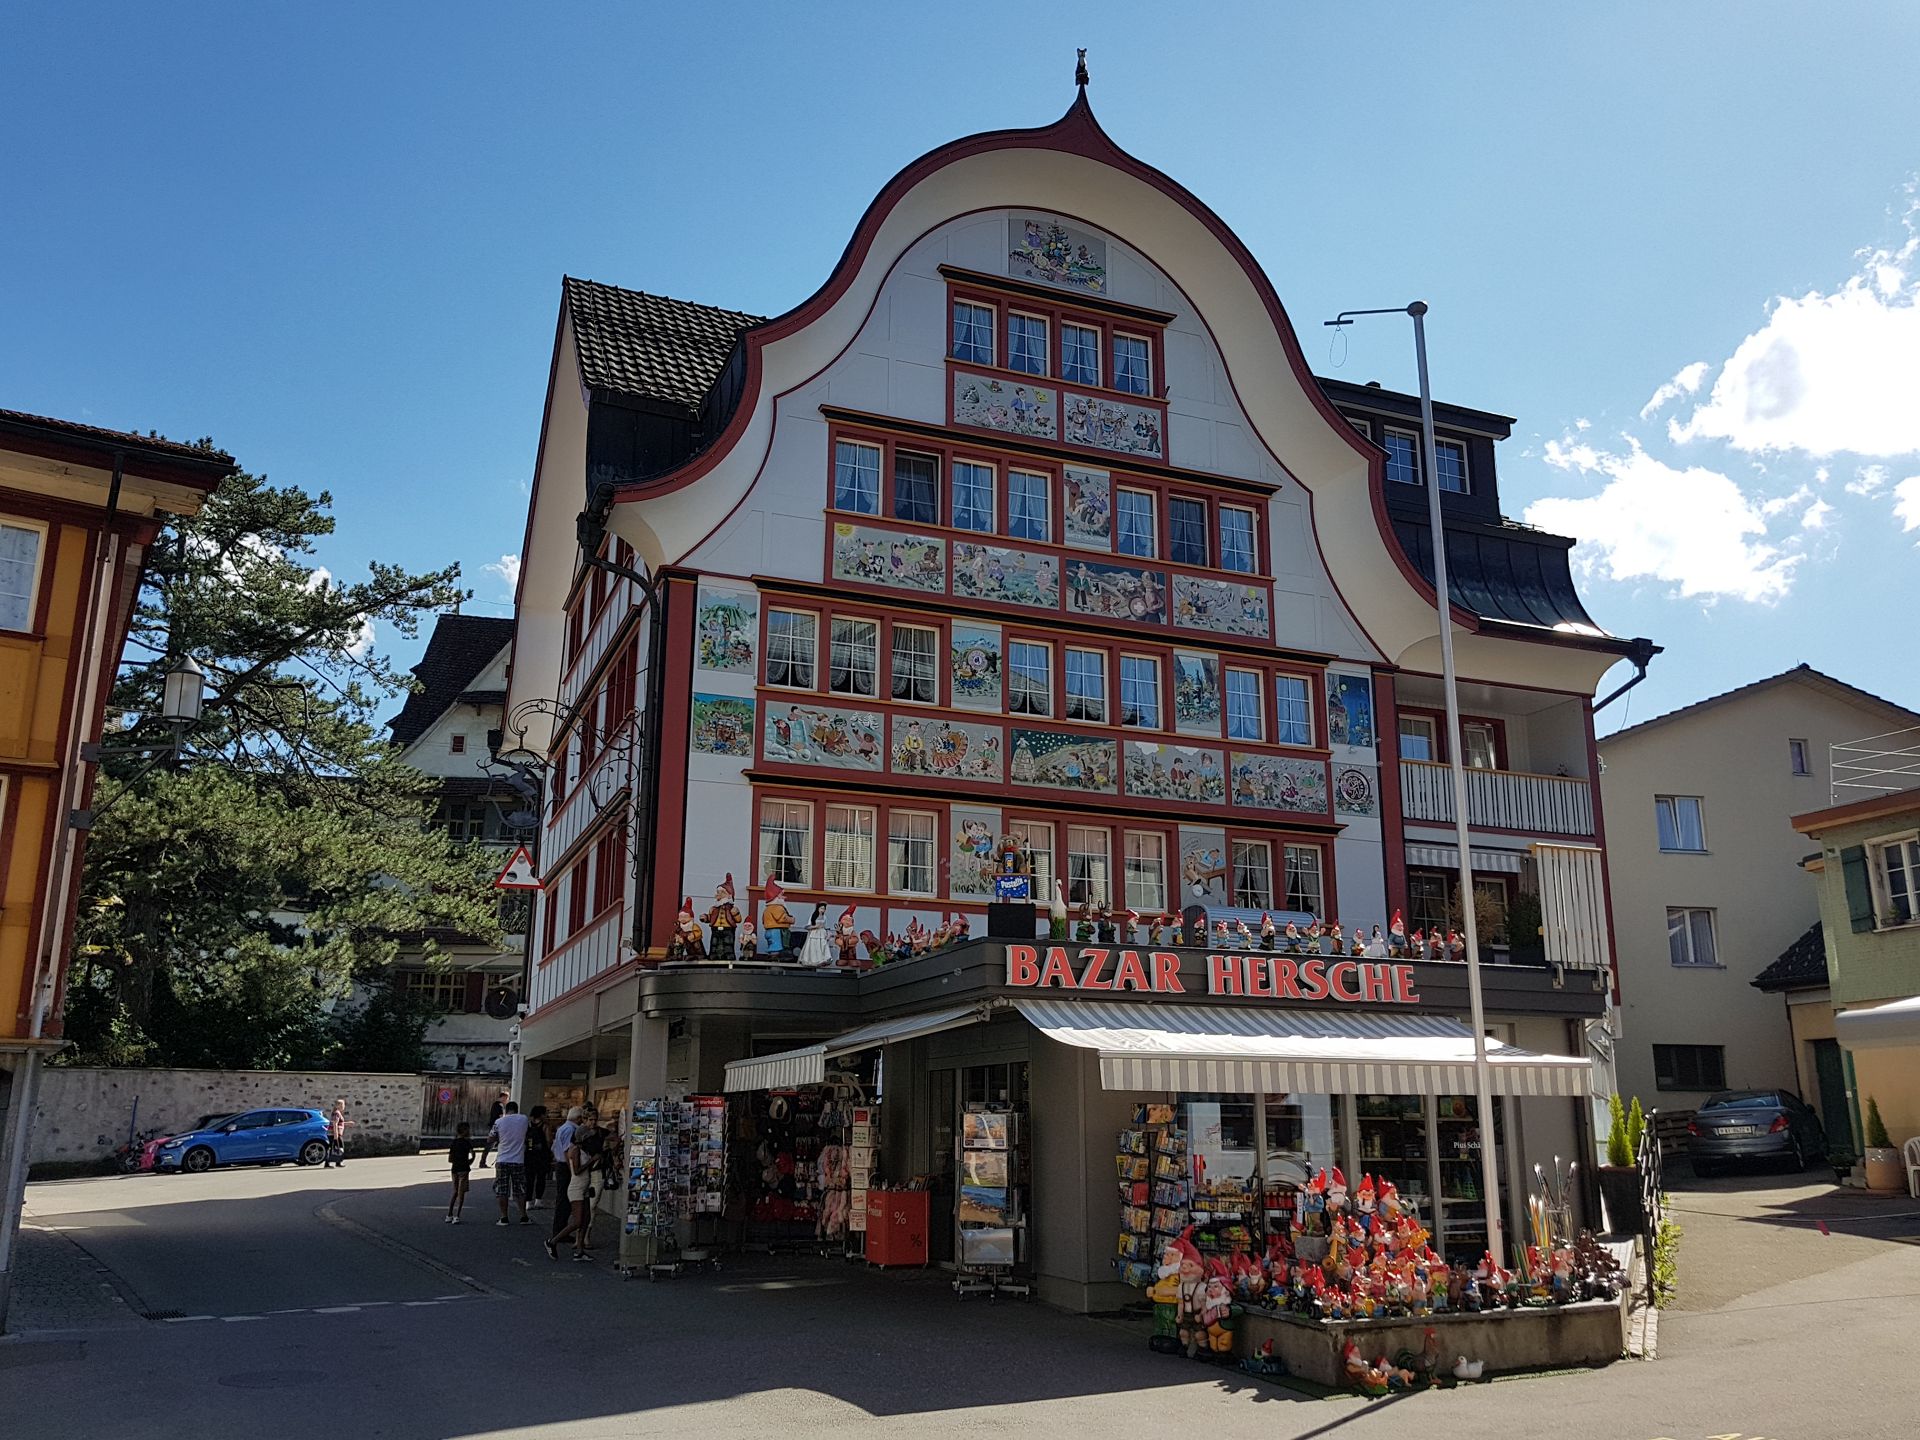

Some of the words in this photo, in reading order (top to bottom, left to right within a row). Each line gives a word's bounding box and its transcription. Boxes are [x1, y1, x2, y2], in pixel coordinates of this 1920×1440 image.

[1005, 944, 1186, 994] BAZAR
[1207, 955, 1421, 1004] HERSCHE
[894, 1211, 907, 1225] %
